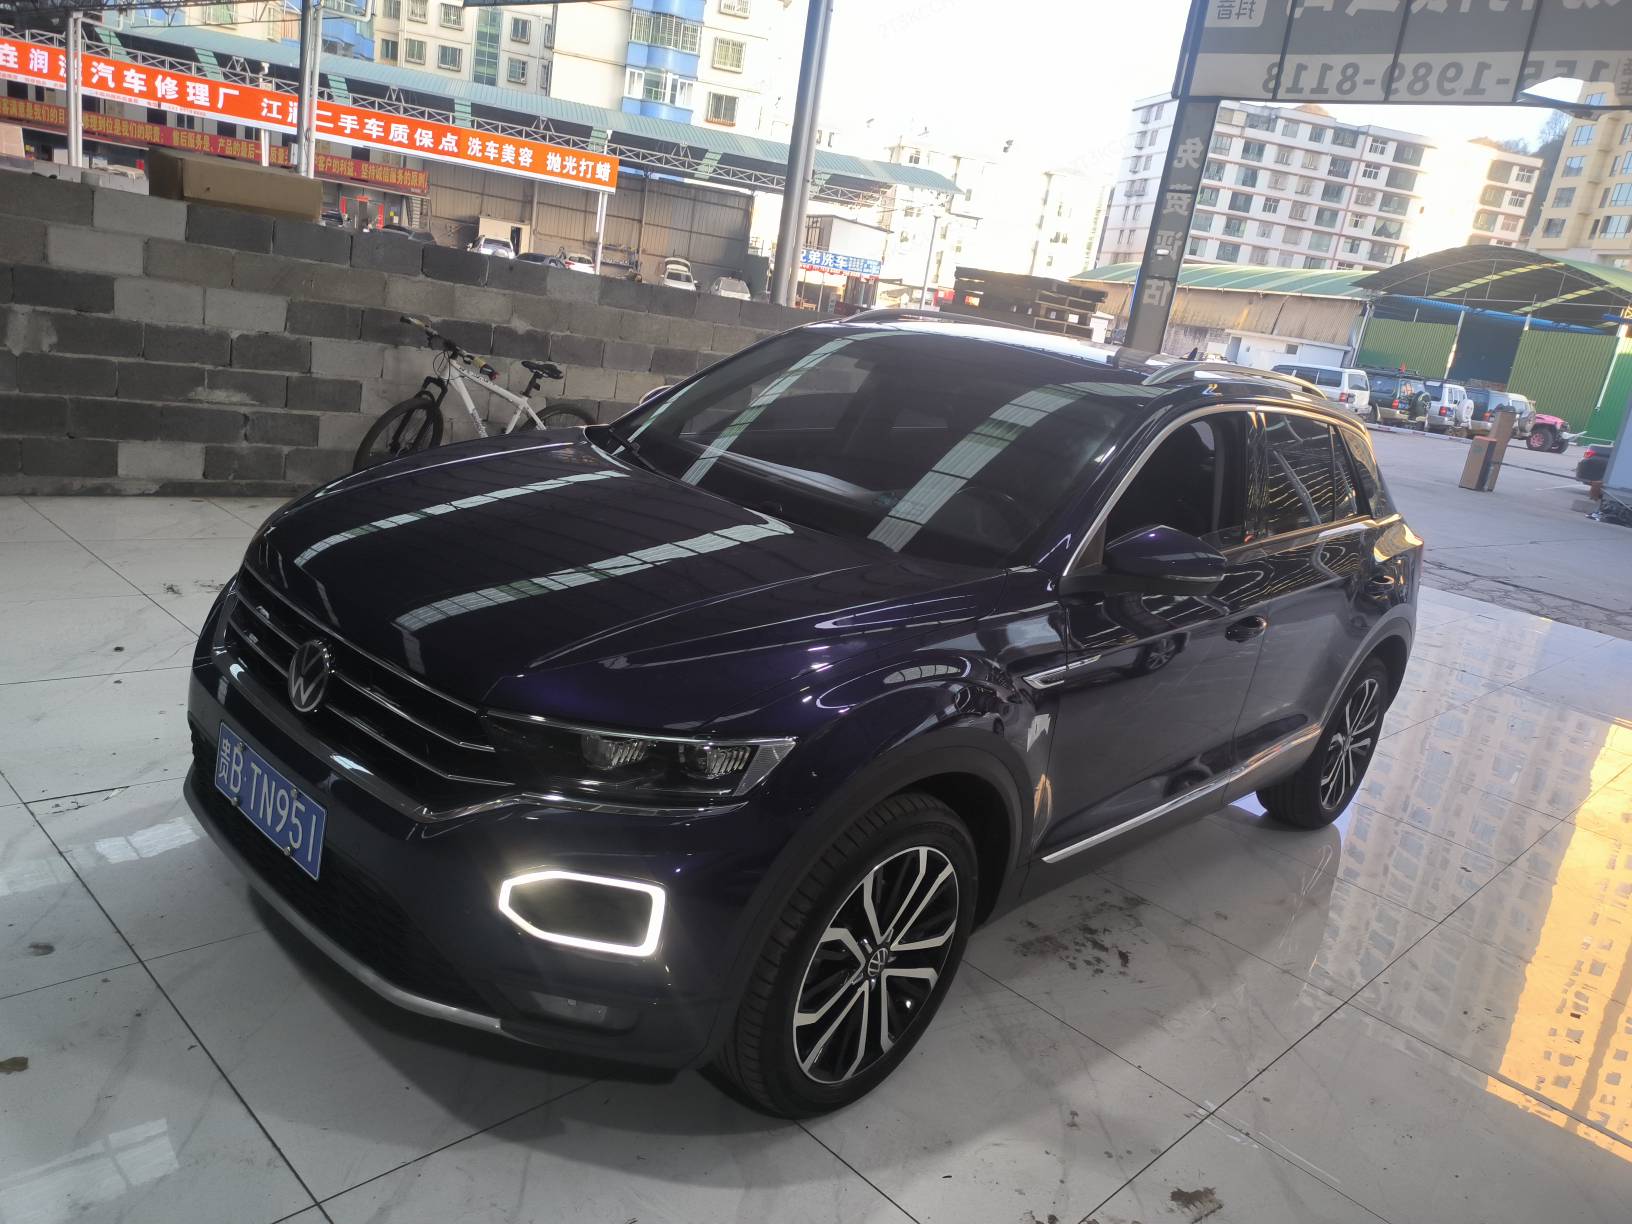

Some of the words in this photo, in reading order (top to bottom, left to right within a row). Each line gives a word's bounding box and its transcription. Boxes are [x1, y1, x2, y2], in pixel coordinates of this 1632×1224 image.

[467, 136, 534, 168] 洗车美容
[546, 152, 611, 183] 抛光打蜡
